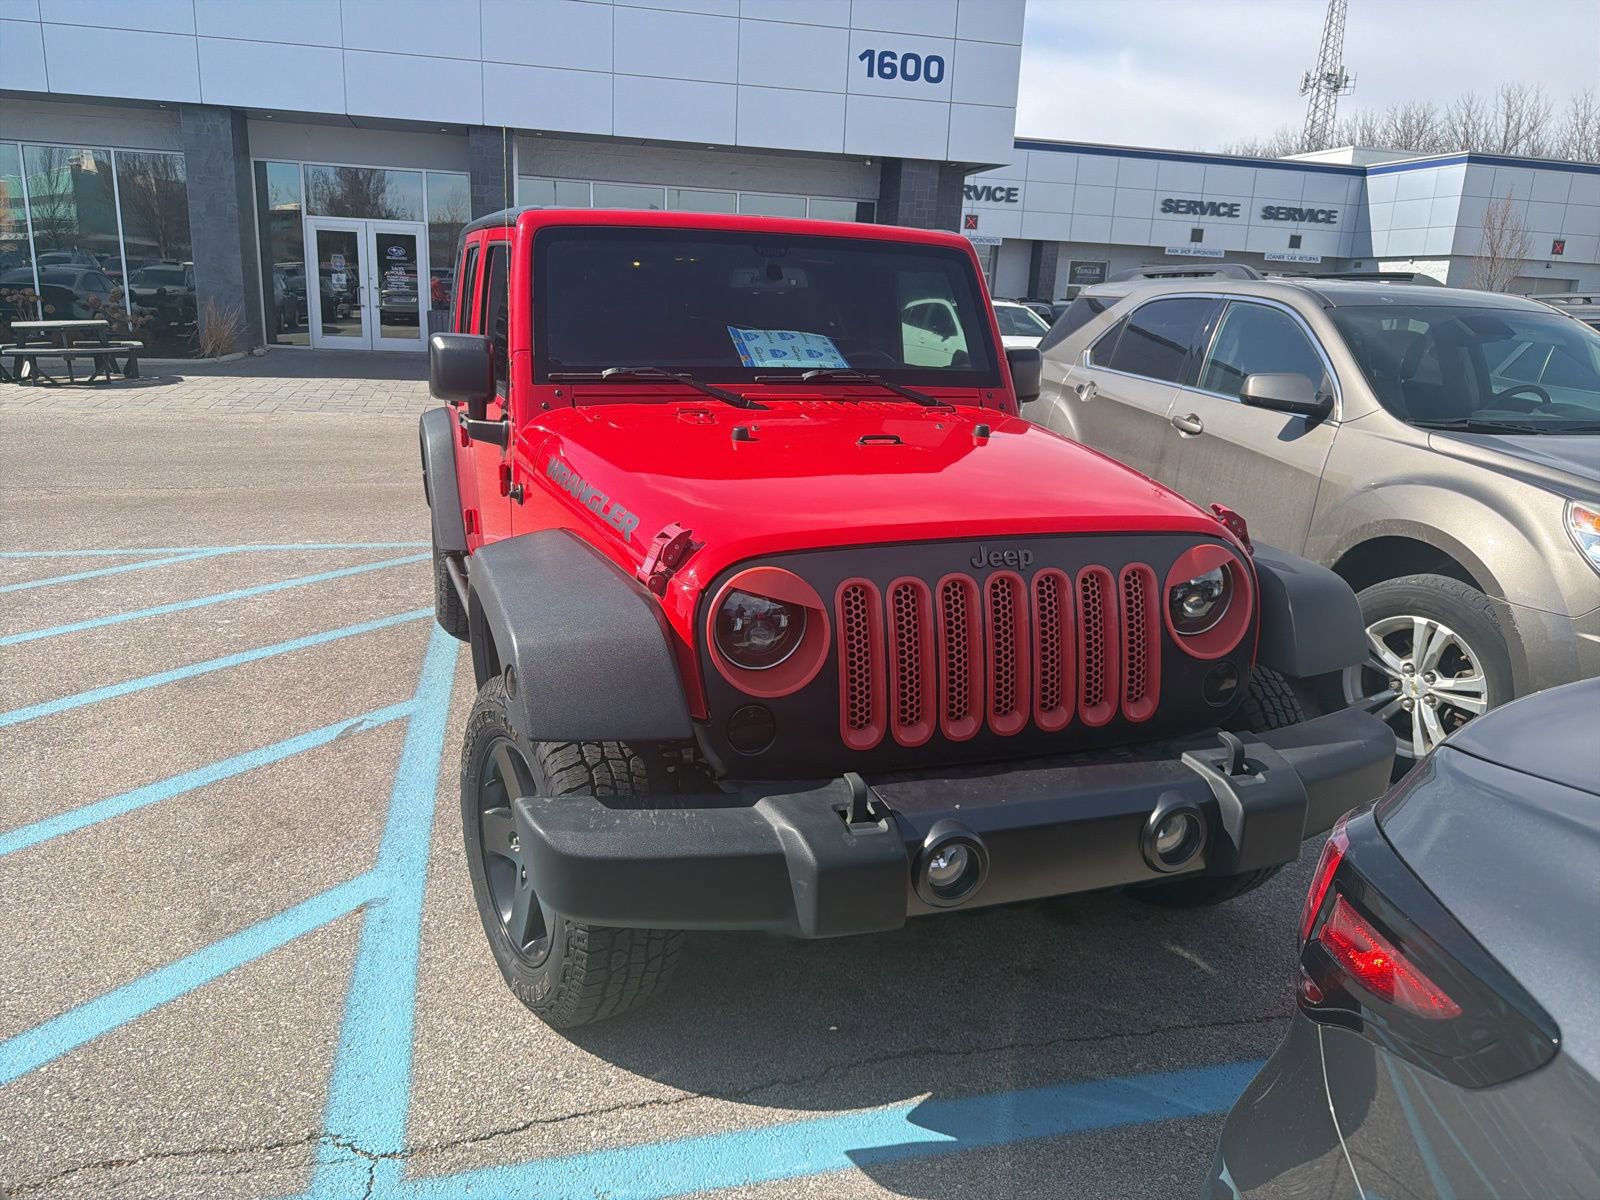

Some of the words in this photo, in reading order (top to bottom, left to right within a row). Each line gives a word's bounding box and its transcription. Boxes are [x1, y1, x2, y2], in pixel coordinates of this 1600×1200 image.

[858, 49, 945, 84] 1600
[1161, 198, 1241, 218] SERVICE
[1261, 205, 1338, 224] SERVICE
[546, 455, 640, 542] WRANGLER
[970, 545, 1034, 571] Jeep
